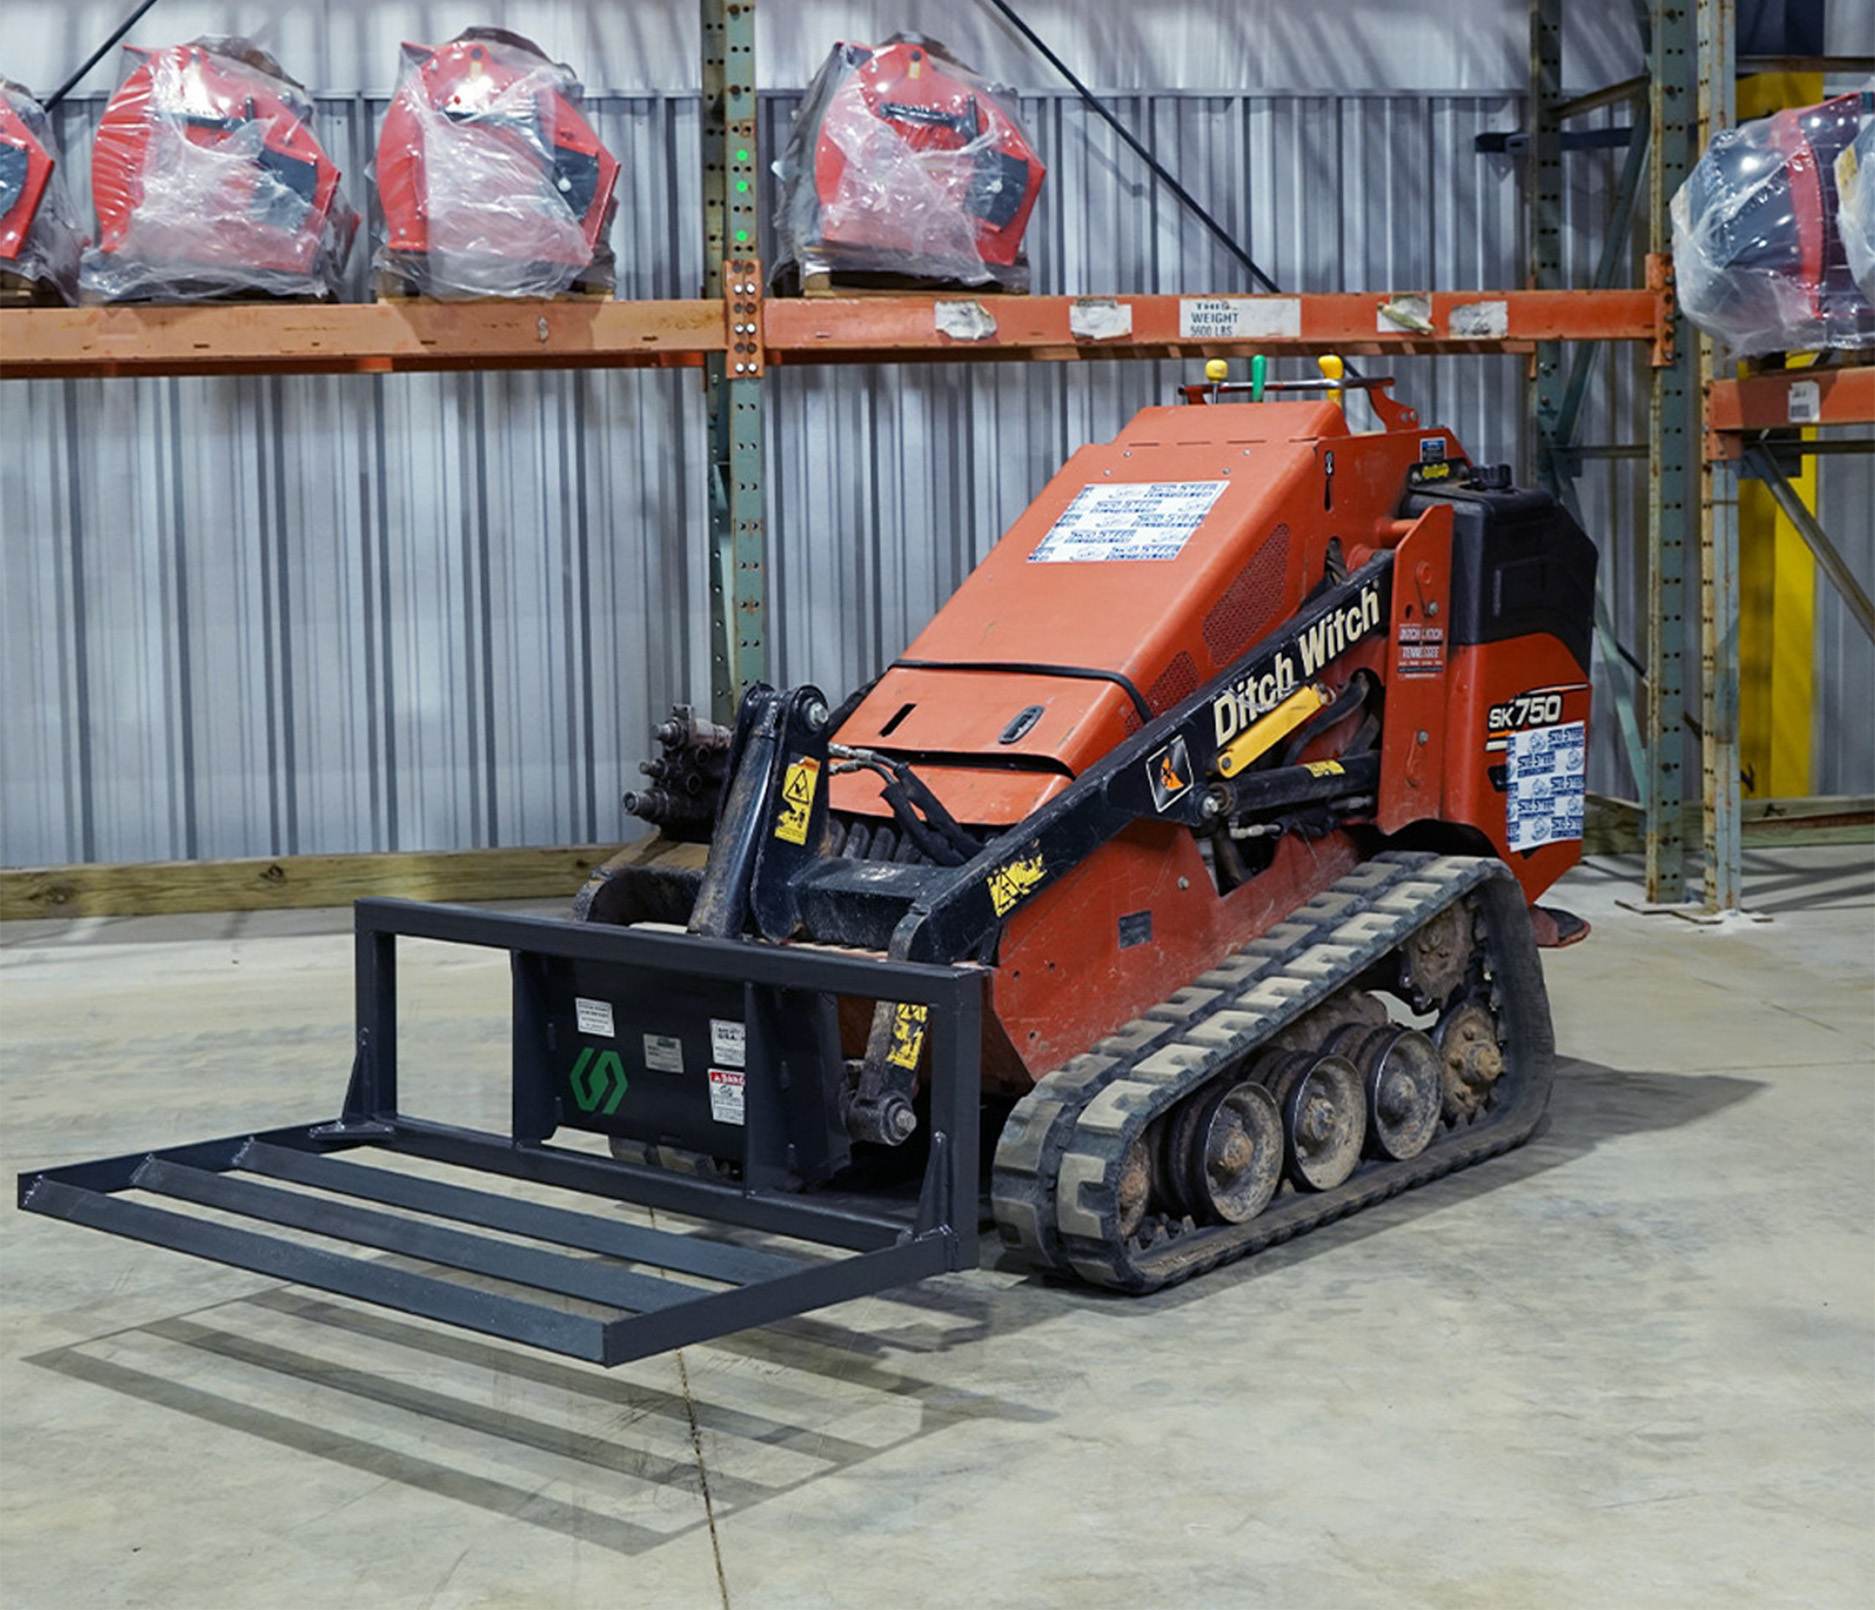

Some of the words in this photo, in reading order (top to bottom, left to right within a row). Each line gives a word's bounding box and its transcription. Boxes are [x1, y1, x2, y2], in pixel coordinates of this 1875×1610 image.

[1190, 312, 1240, 324] WEIGHT
[1213, 652, 1294, 748] Ditch
[1298, 587, 1380, 677] Witch
[1489, 695, 1562, 728] SK750
